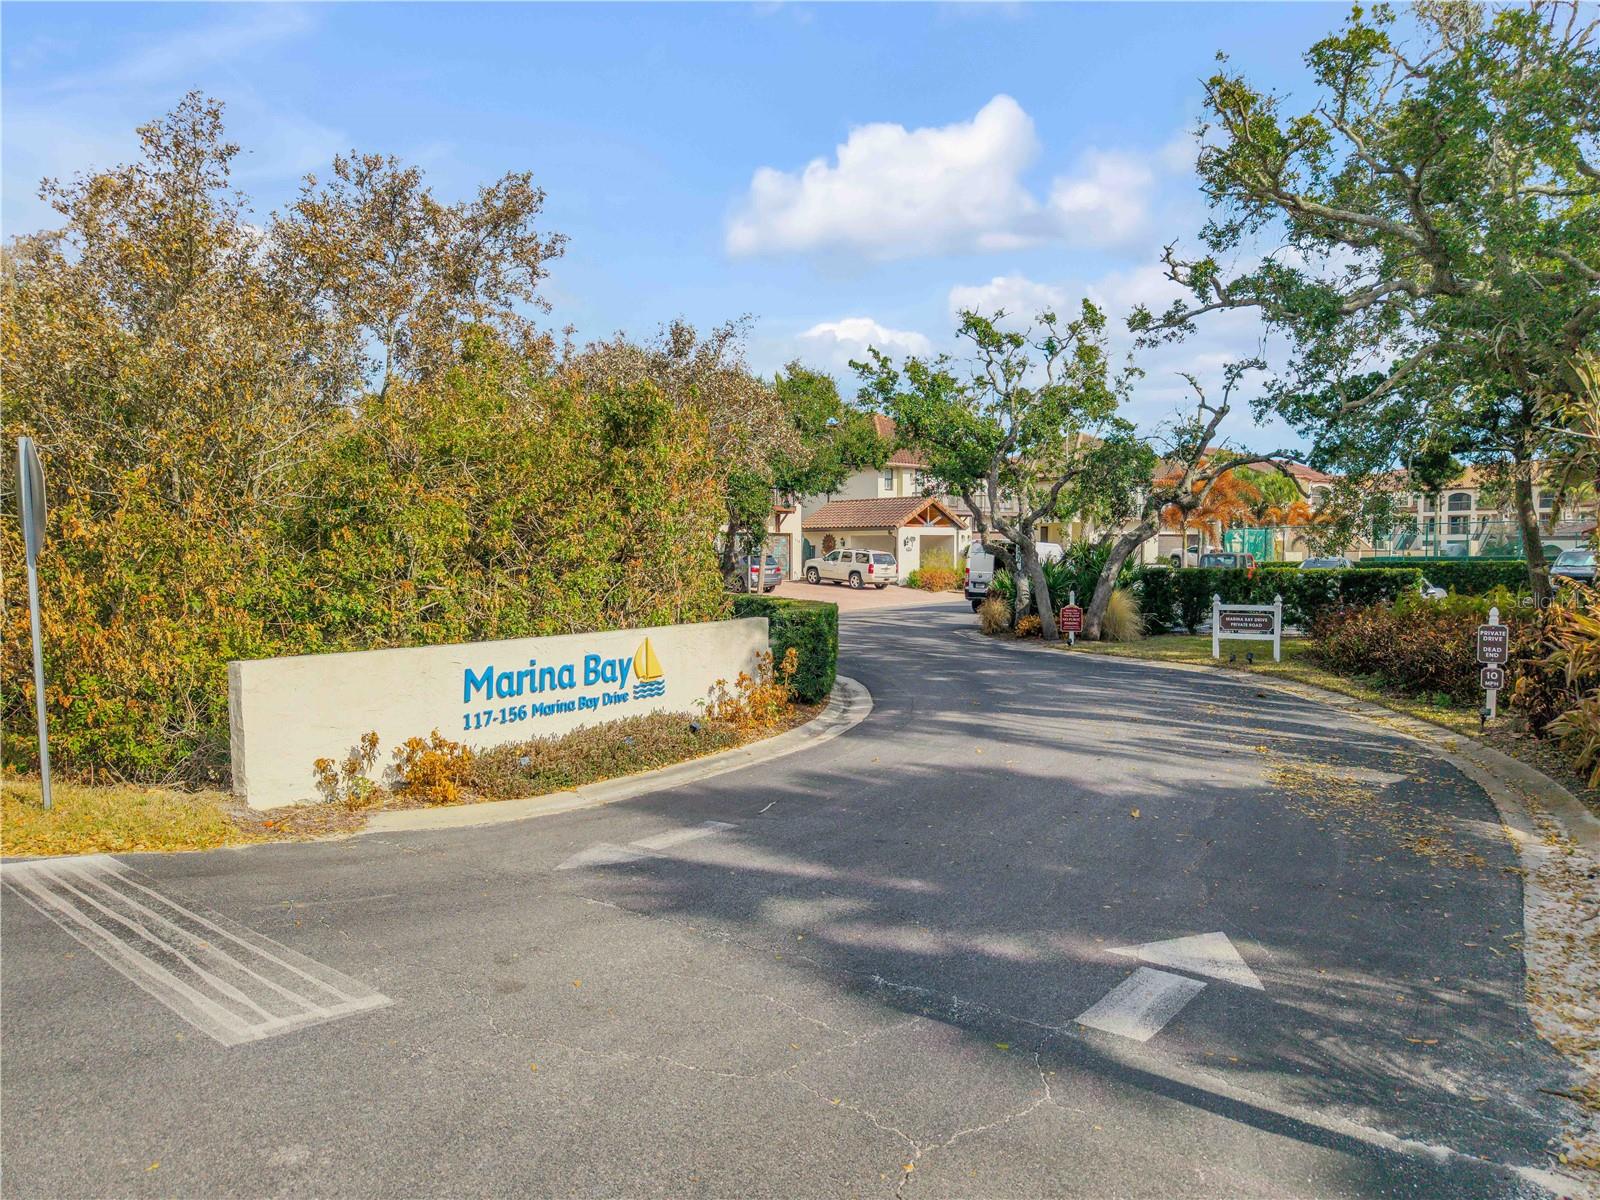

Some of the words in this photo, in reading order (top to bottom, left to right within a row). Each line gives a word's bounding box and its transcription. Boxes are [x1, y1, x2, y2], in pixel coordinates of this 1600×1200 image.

[463, 659, 576, 704] Marina
[583, 653, 632, 689] Bay
[1486, 671, 1498, 680] 10
[463, 704, 527, 731] 117-156
[531, 698, 576, 719] Marina
[578, 694, 600, 712] Bay
[602, 691, 630, 707] Drive
